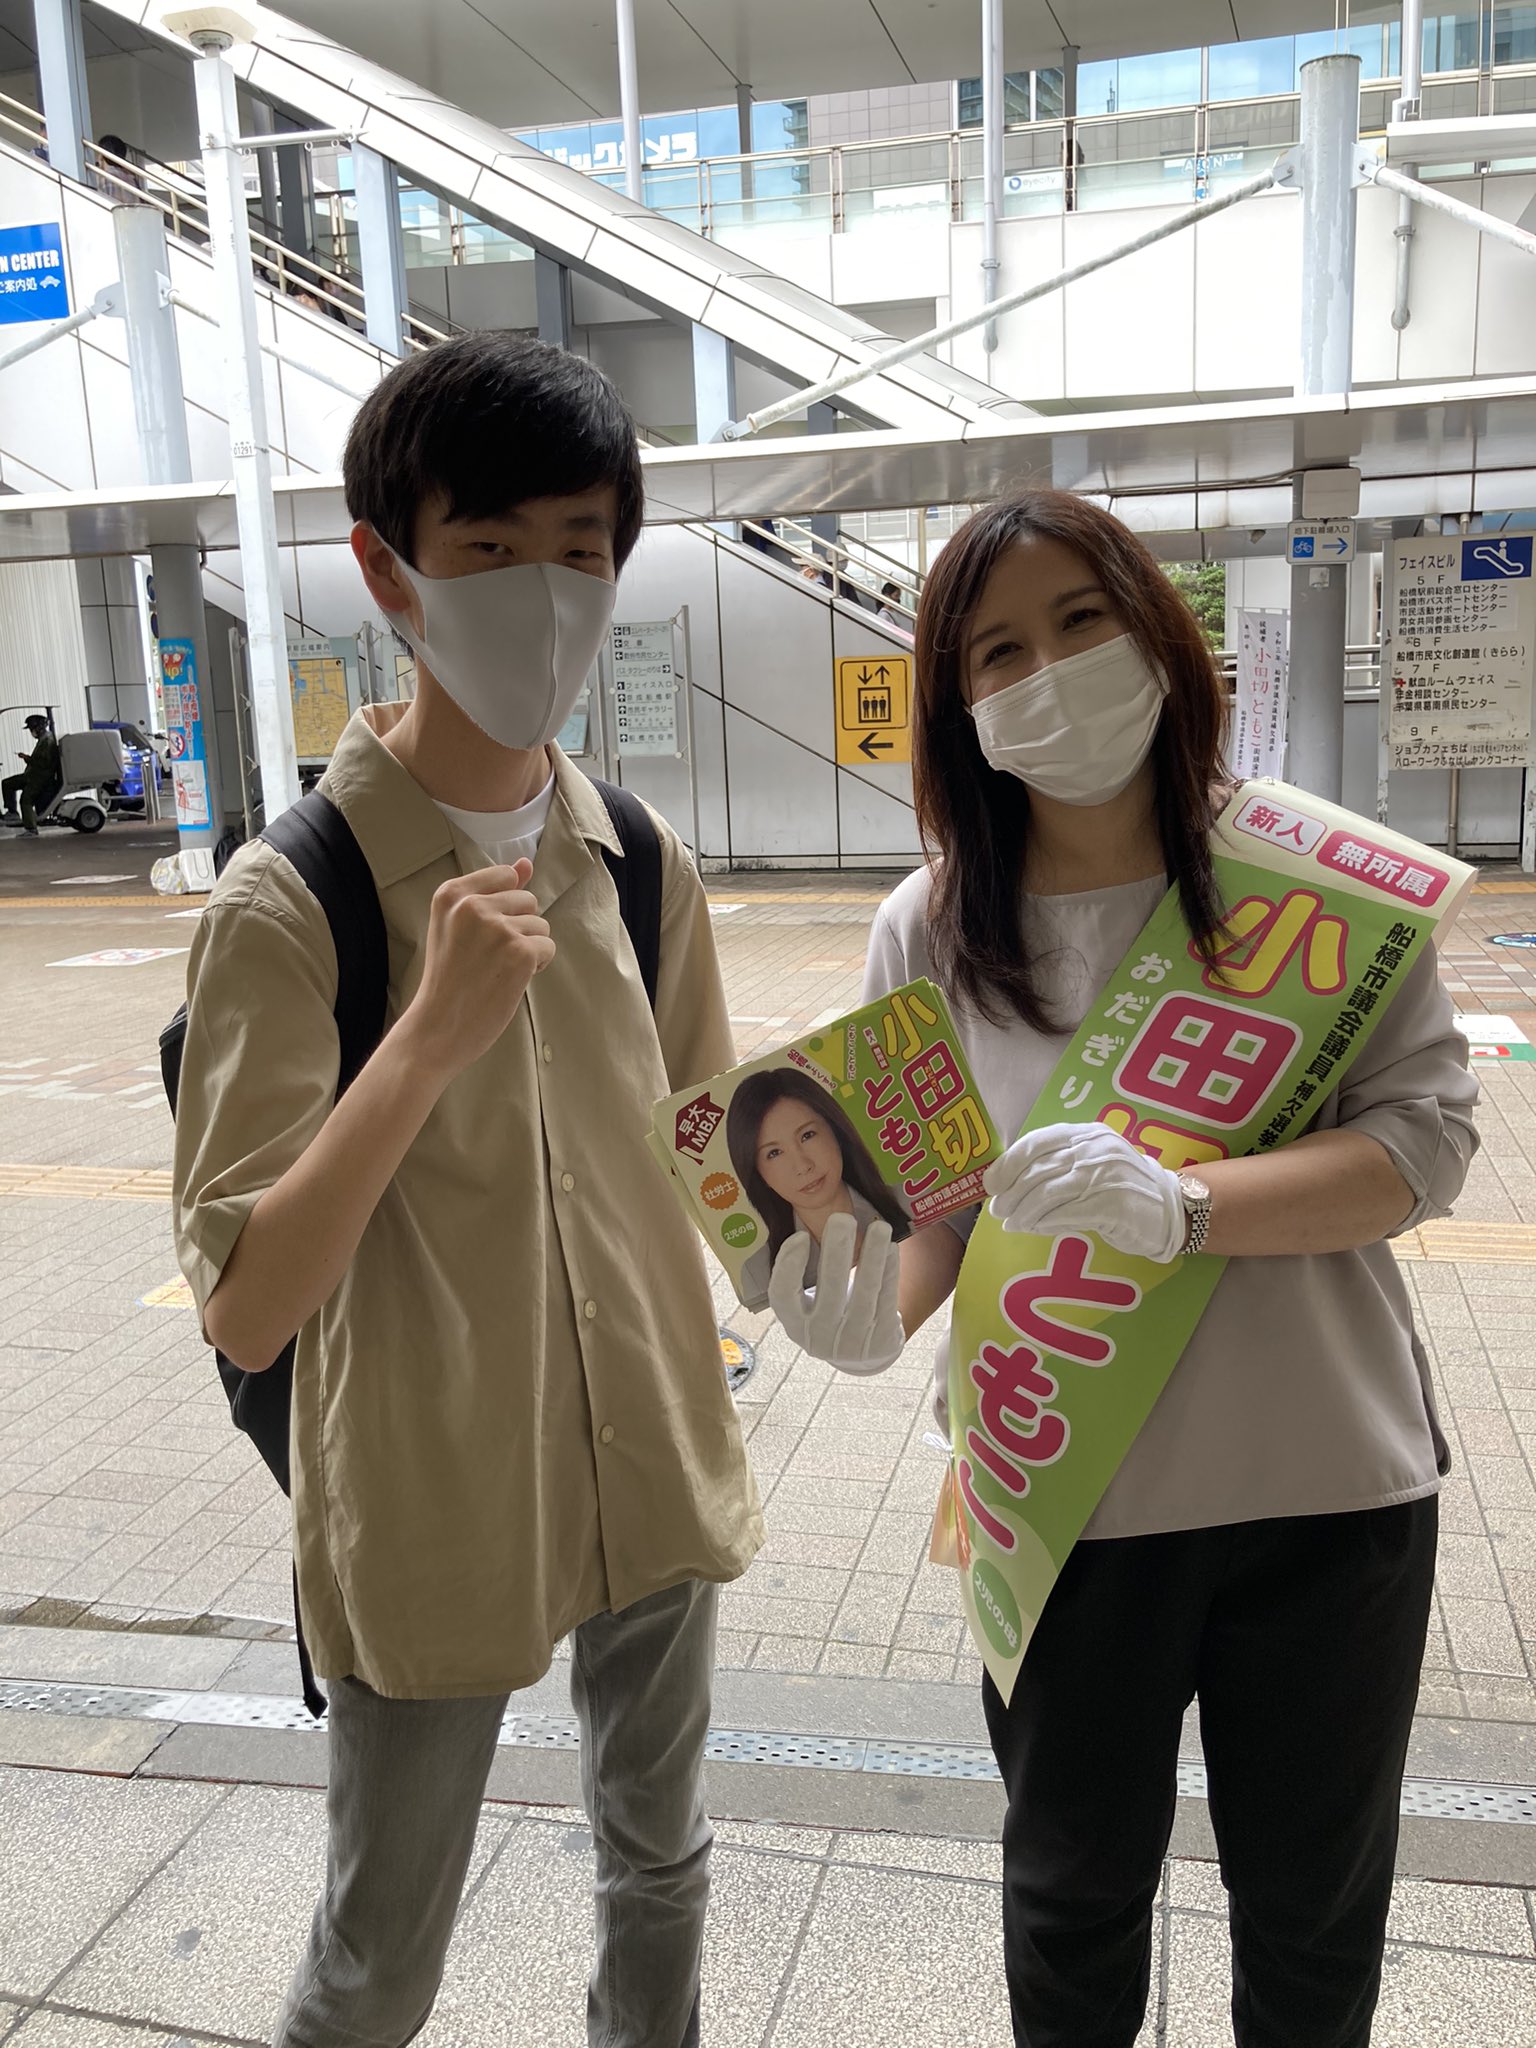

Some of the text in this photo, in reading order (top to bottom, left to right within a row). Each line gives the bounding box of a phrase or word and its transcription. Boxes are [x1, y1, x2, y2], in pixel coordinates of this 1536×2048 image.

[11, 249, 60, 272] CENTER
[233, 446, 254, 456] 01291
[1399, 554, 1456, 570] フェイスビル
[1399, 583, 1508, 597] 船橋駅前総合窓口センター
[1399, 593, 1508, 607] 船橋市パスポートセンター
[1399, 603, 1507, 616] 市民活動サポートセンター
[1399, 613, 1489, 626] 男女共同参画センター
[1398, 623, 1497, 636] 船橋市消費生活センター
[1395, 687, 1470, 700] 年金相談センター
[1245, 804, 1304, 847] 新人
[1332, 840, 1436, 899] 無所属
[1059, 953, 1174, 1110] おだぎり
[1243, 921, 1418, 1157] 船橋市議会議員 補欠選挙
[881, 993, 992, 1175] 小田切
[680, 1104, 706, 1137] 早大
[691, 1110, 722, 1148] MBA
[863, 1074, 941, 1197] ともこ
[704, 1181, 735, 1201] 社労士
[724, 1221, 755, 1242] 2児の母
[974, 1571, 1018, 1649] 2児の母
